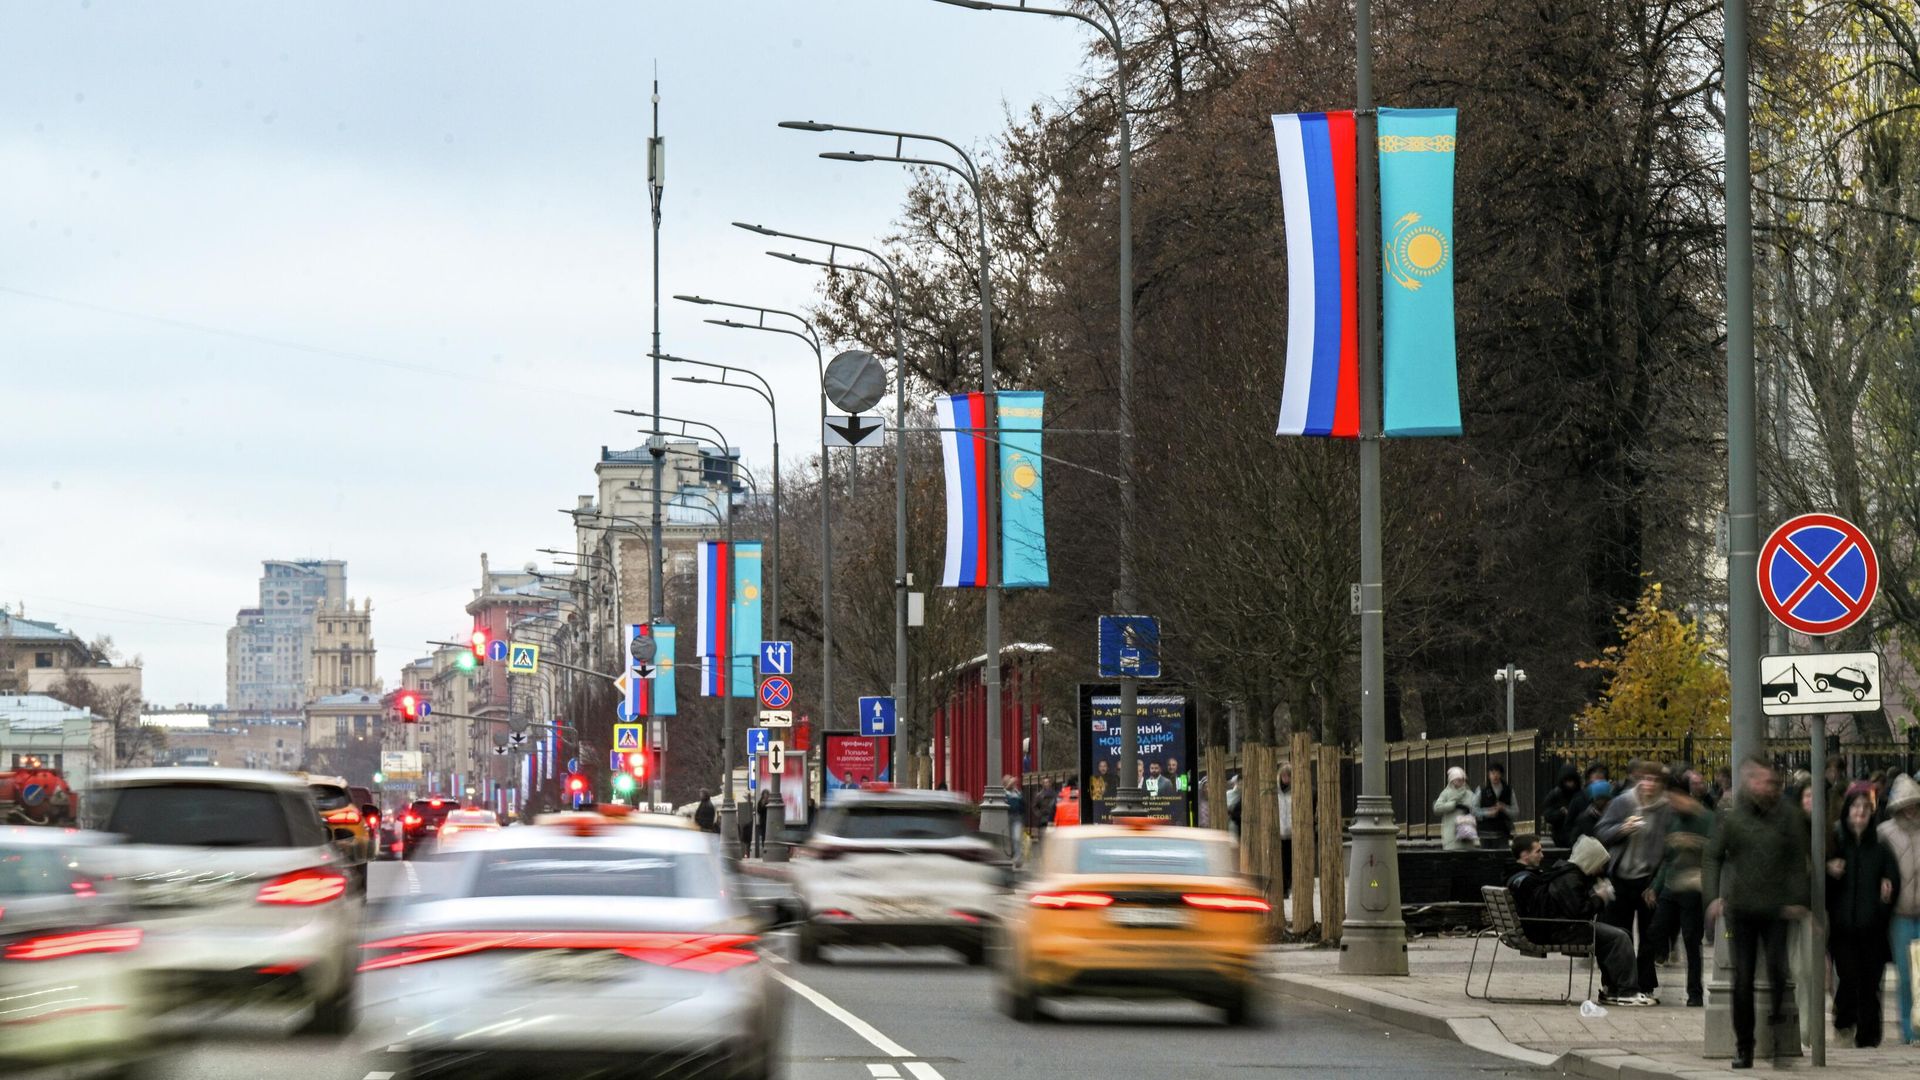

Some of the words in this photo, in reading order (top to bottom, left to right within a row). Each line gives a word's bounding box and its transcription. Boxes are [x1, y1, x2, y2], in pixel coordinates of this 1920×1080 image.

[1104, 708, 1148, 717] ДЕКРЯ
[1109, 723, 1162, 736] ГЛНЫЙ
[1099, 732, 1174, 746] НОВОДНИЙ
[1110, 744, 1164, 756] КЦЕРТ
